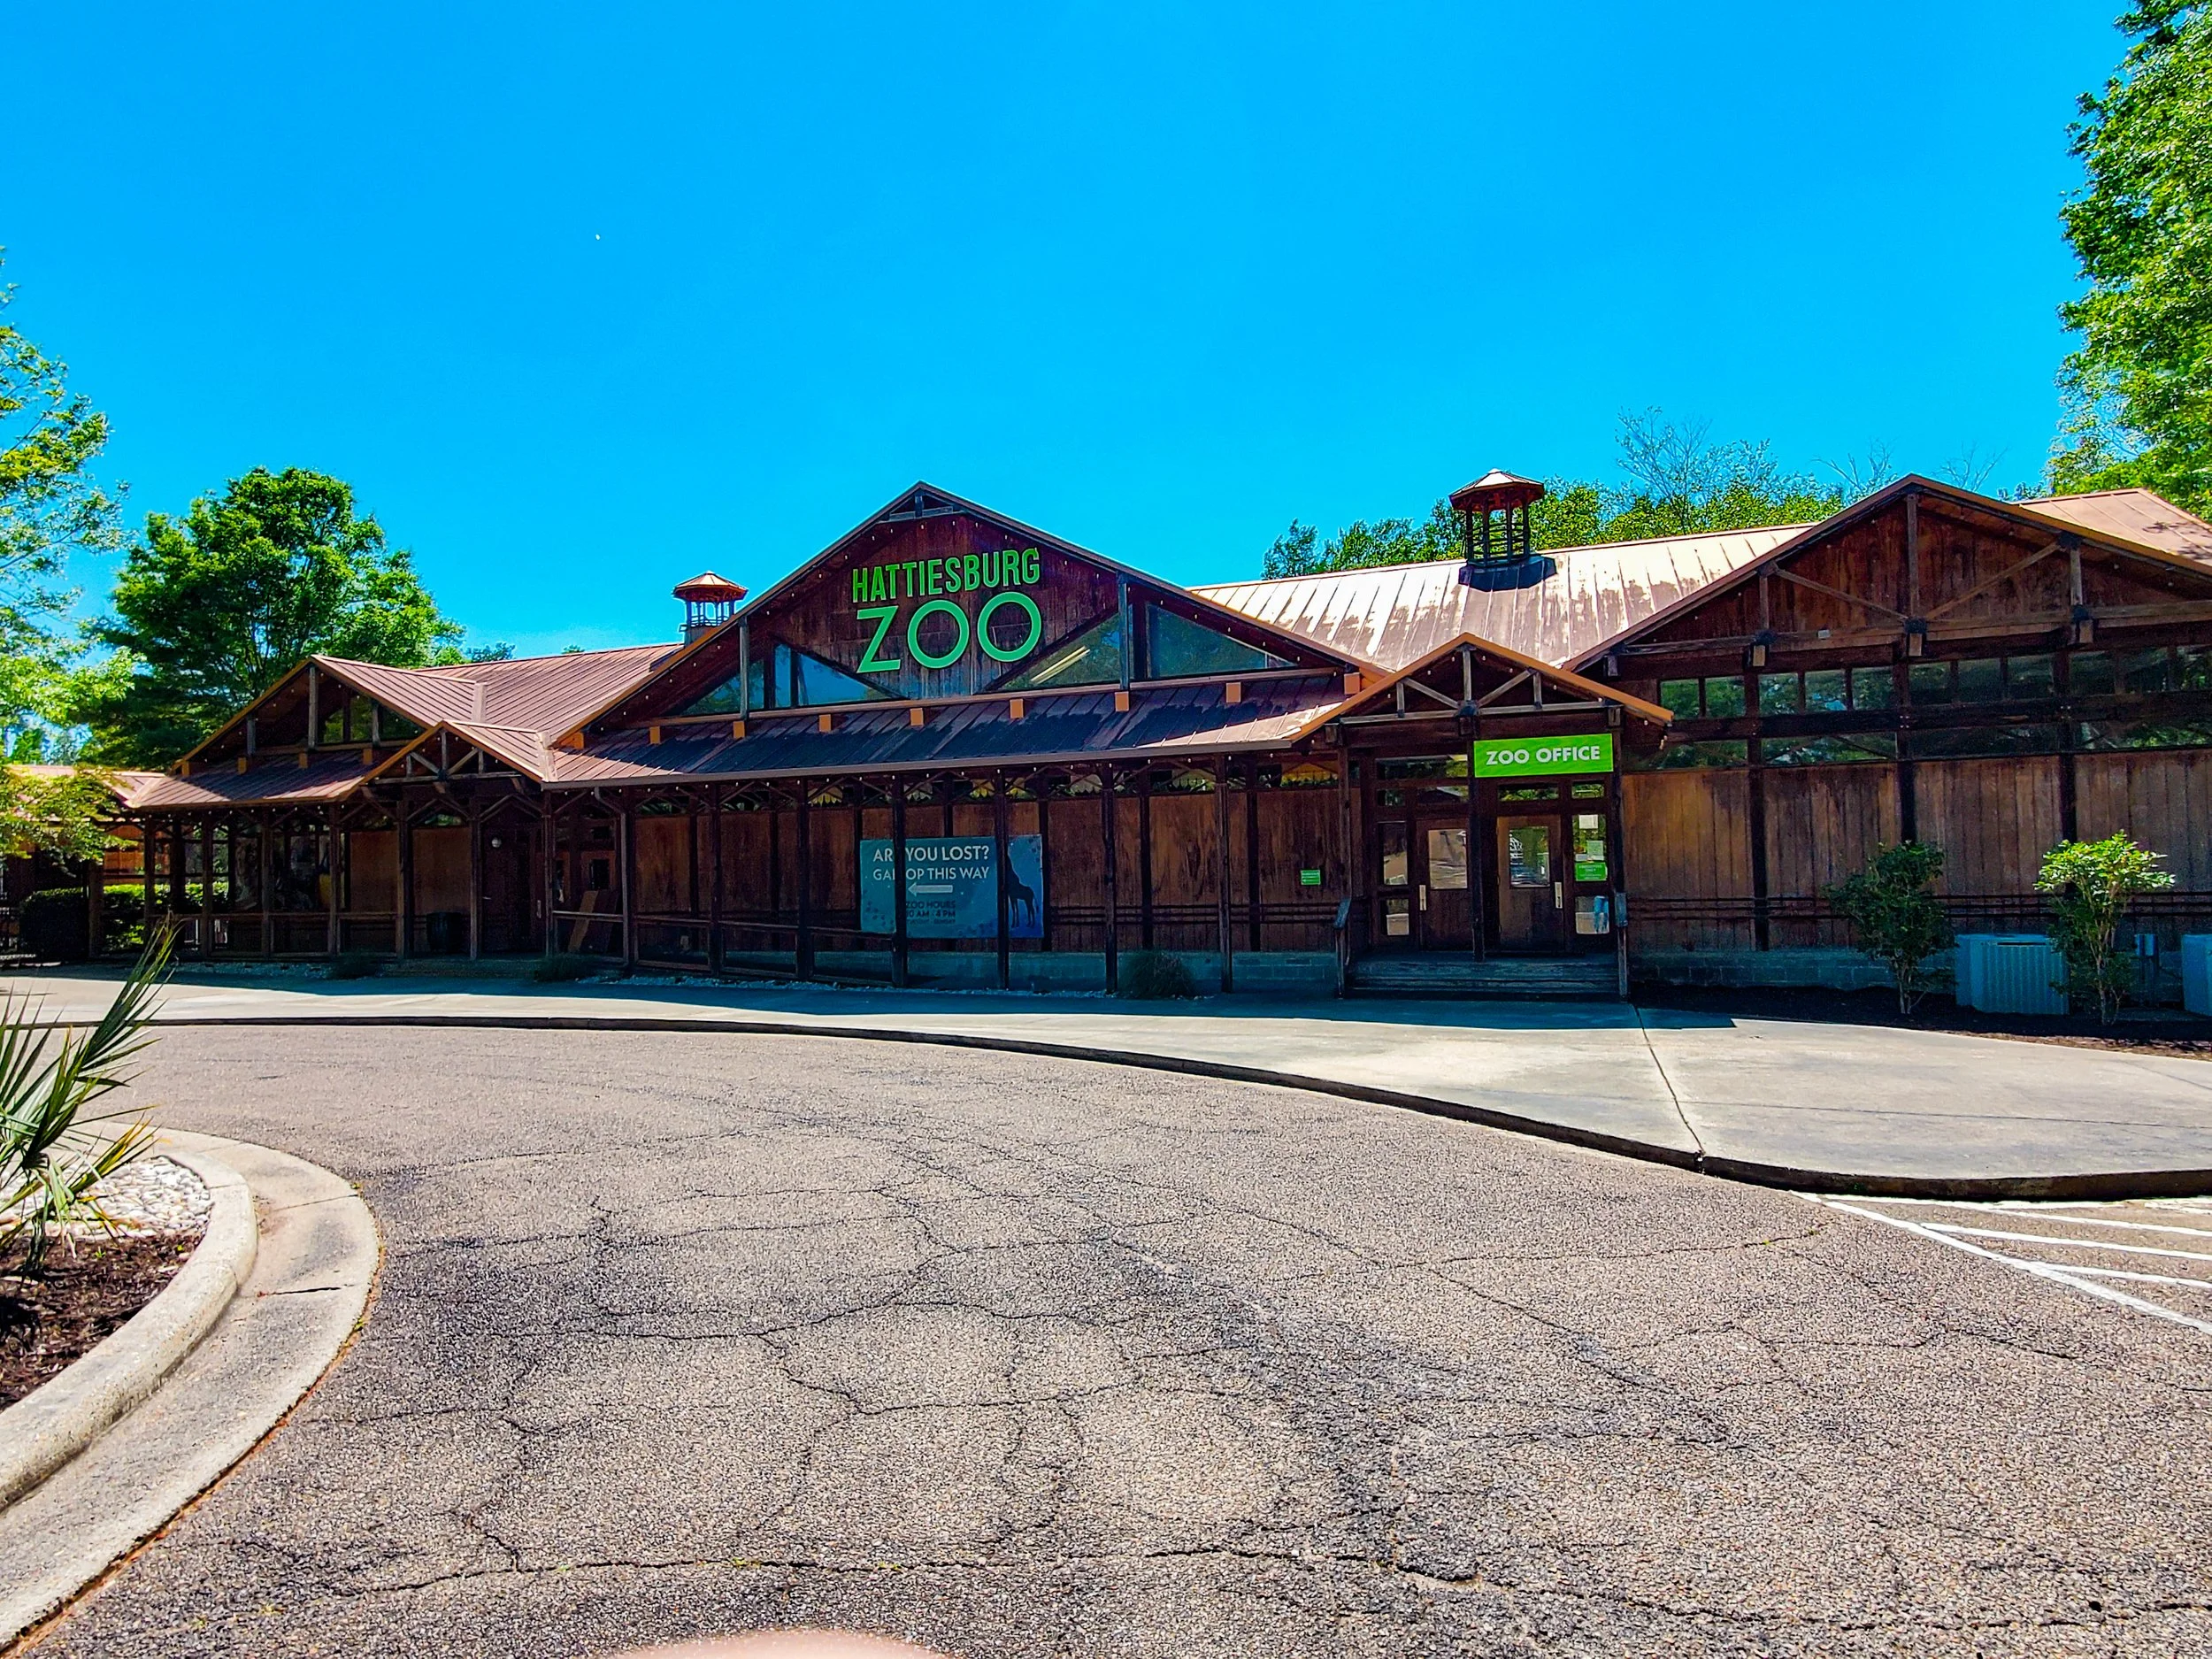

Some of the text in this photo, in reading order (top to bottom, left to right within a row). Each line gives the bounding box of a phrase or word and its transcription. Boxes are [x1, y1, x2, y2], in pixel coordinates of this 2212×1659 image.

[852, 548, 1041, 603] HATTIESBURG
[856, 591, 1042, 673] ZOO
[1486, 746, 1600, 765] ZOO OFFICE
[872, 845, 990, 862] AR YOU LOST?
[872, 866, 989, 881] GALOP THIS WAY
